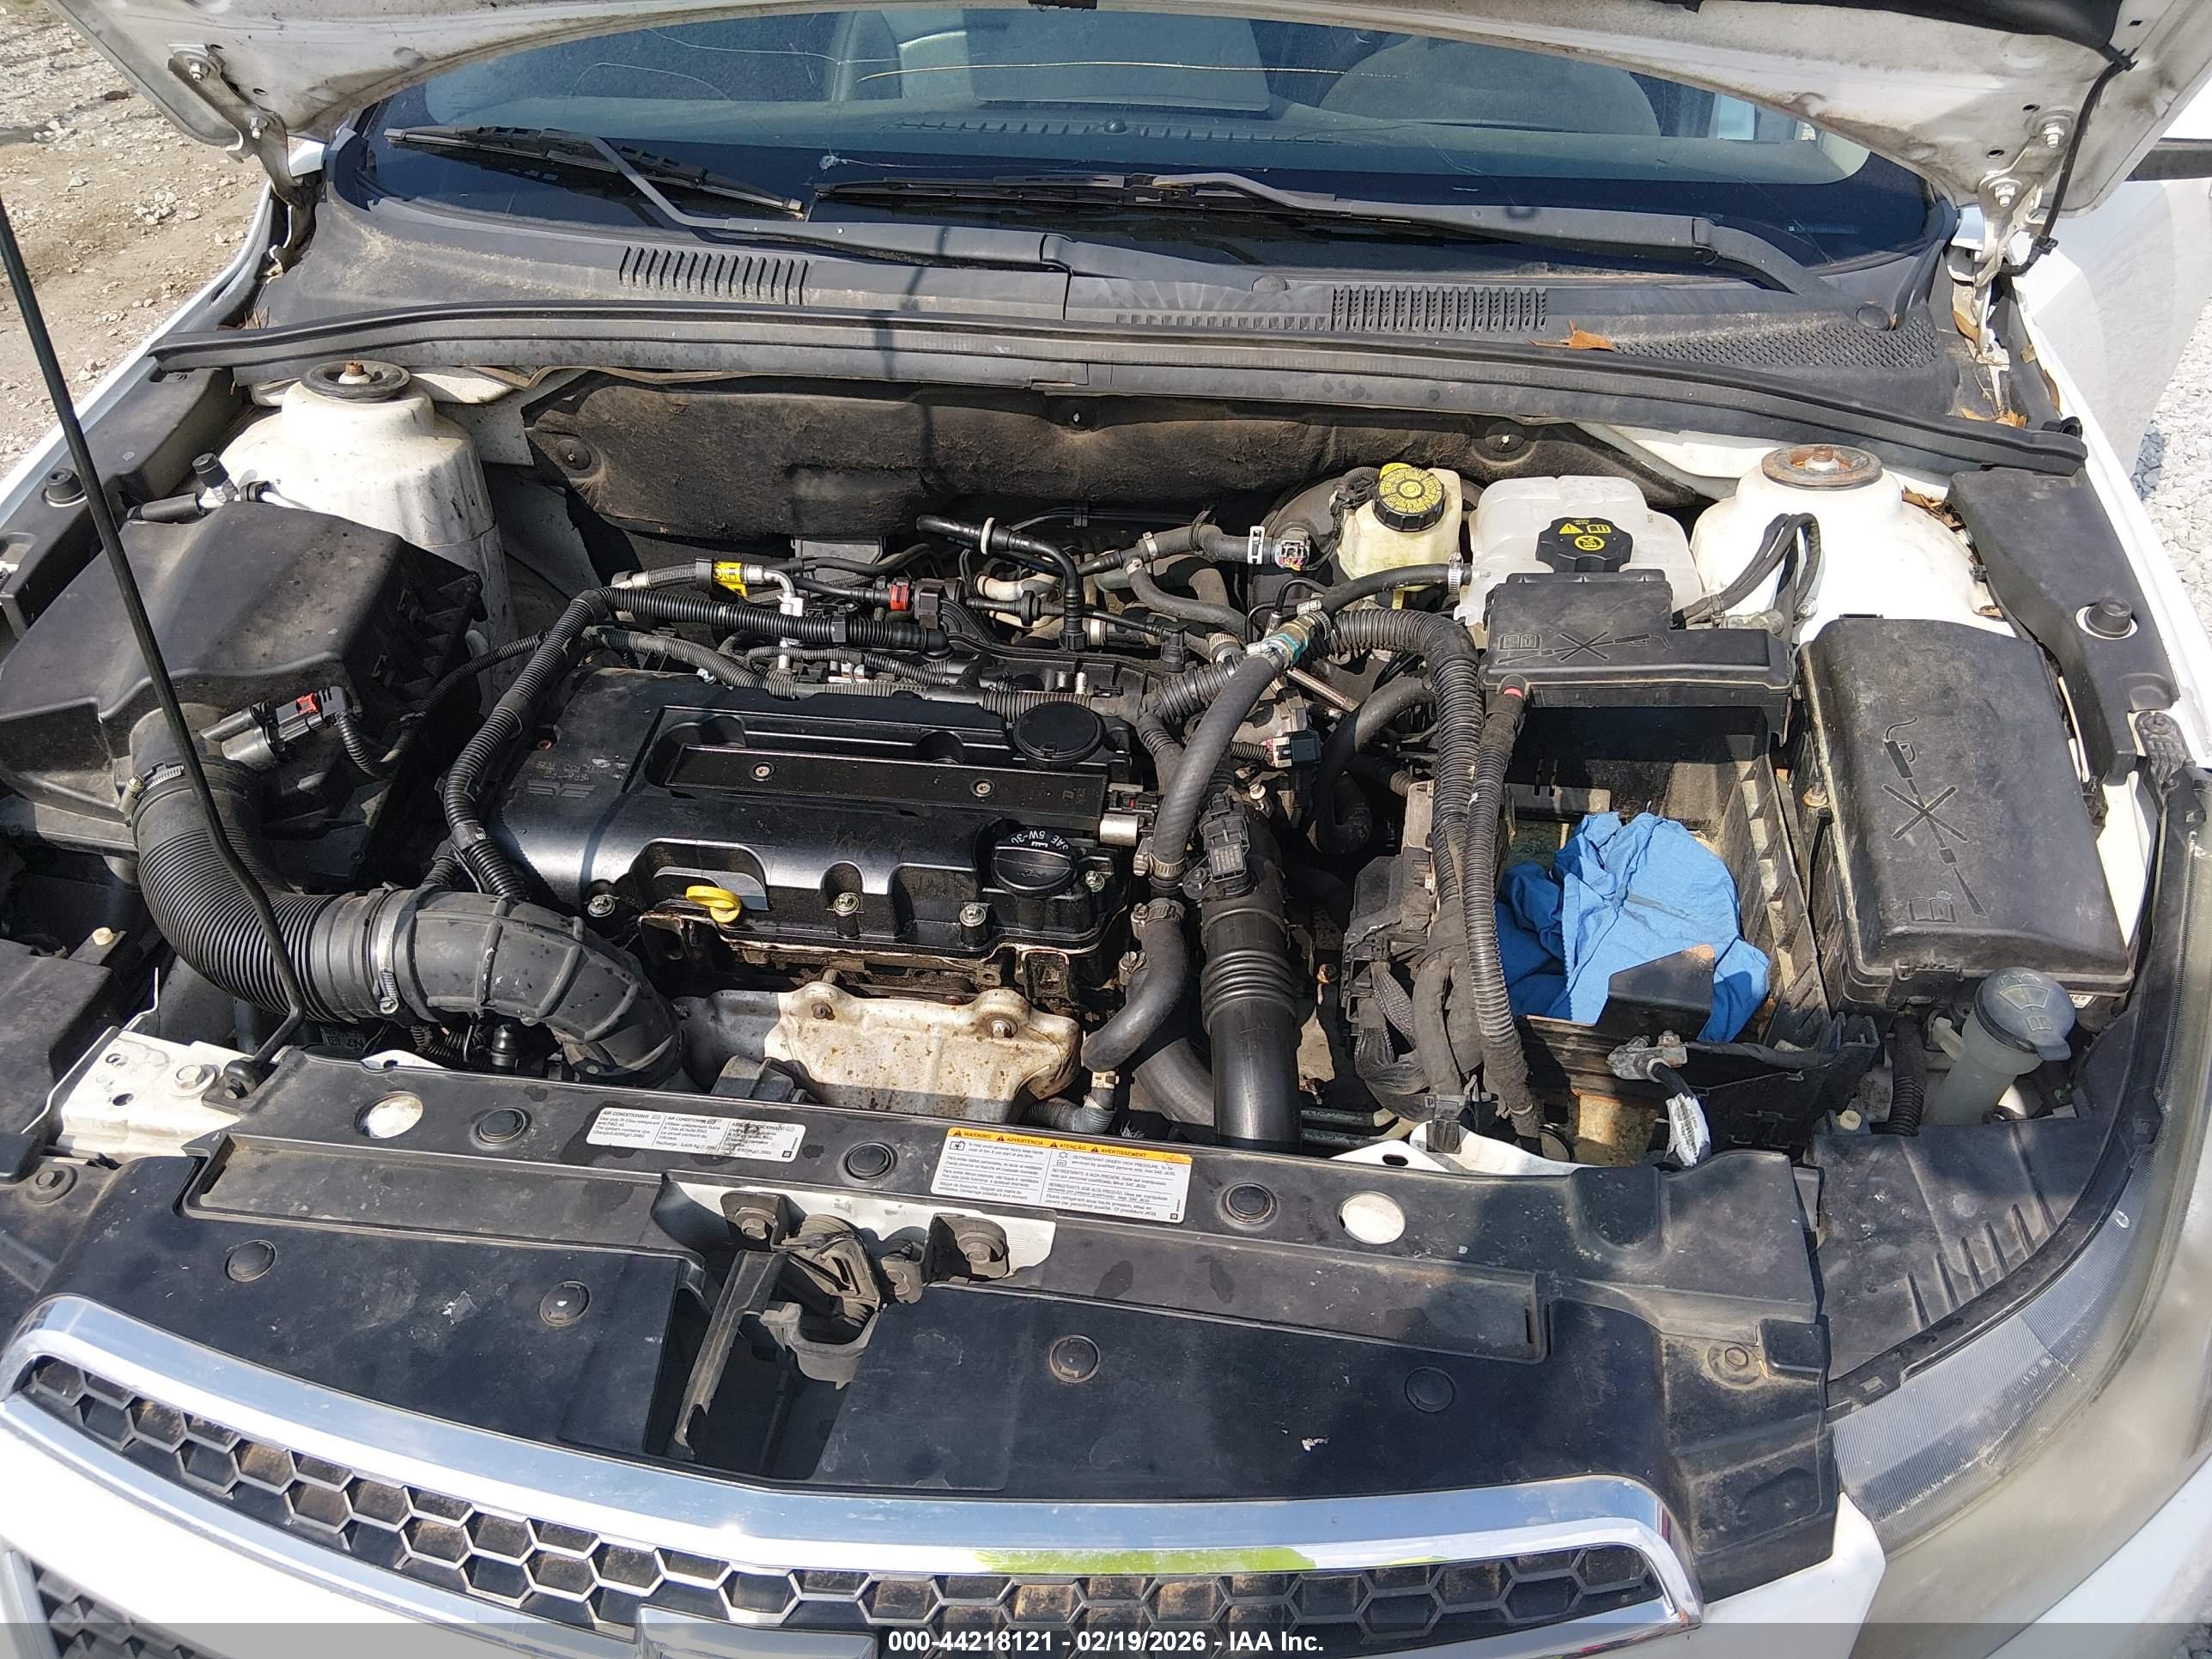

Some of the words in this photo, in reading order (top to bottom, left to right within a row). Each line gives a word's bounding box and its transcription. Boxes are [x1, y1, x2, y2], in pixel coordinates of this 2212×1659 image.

[963, 1131, 991, 1139] WARNING
[1006, 1137, 1043, 1146] ADVERTENCIA
[1100, 1148, 1147, 1158] AVERTISSEMENT
